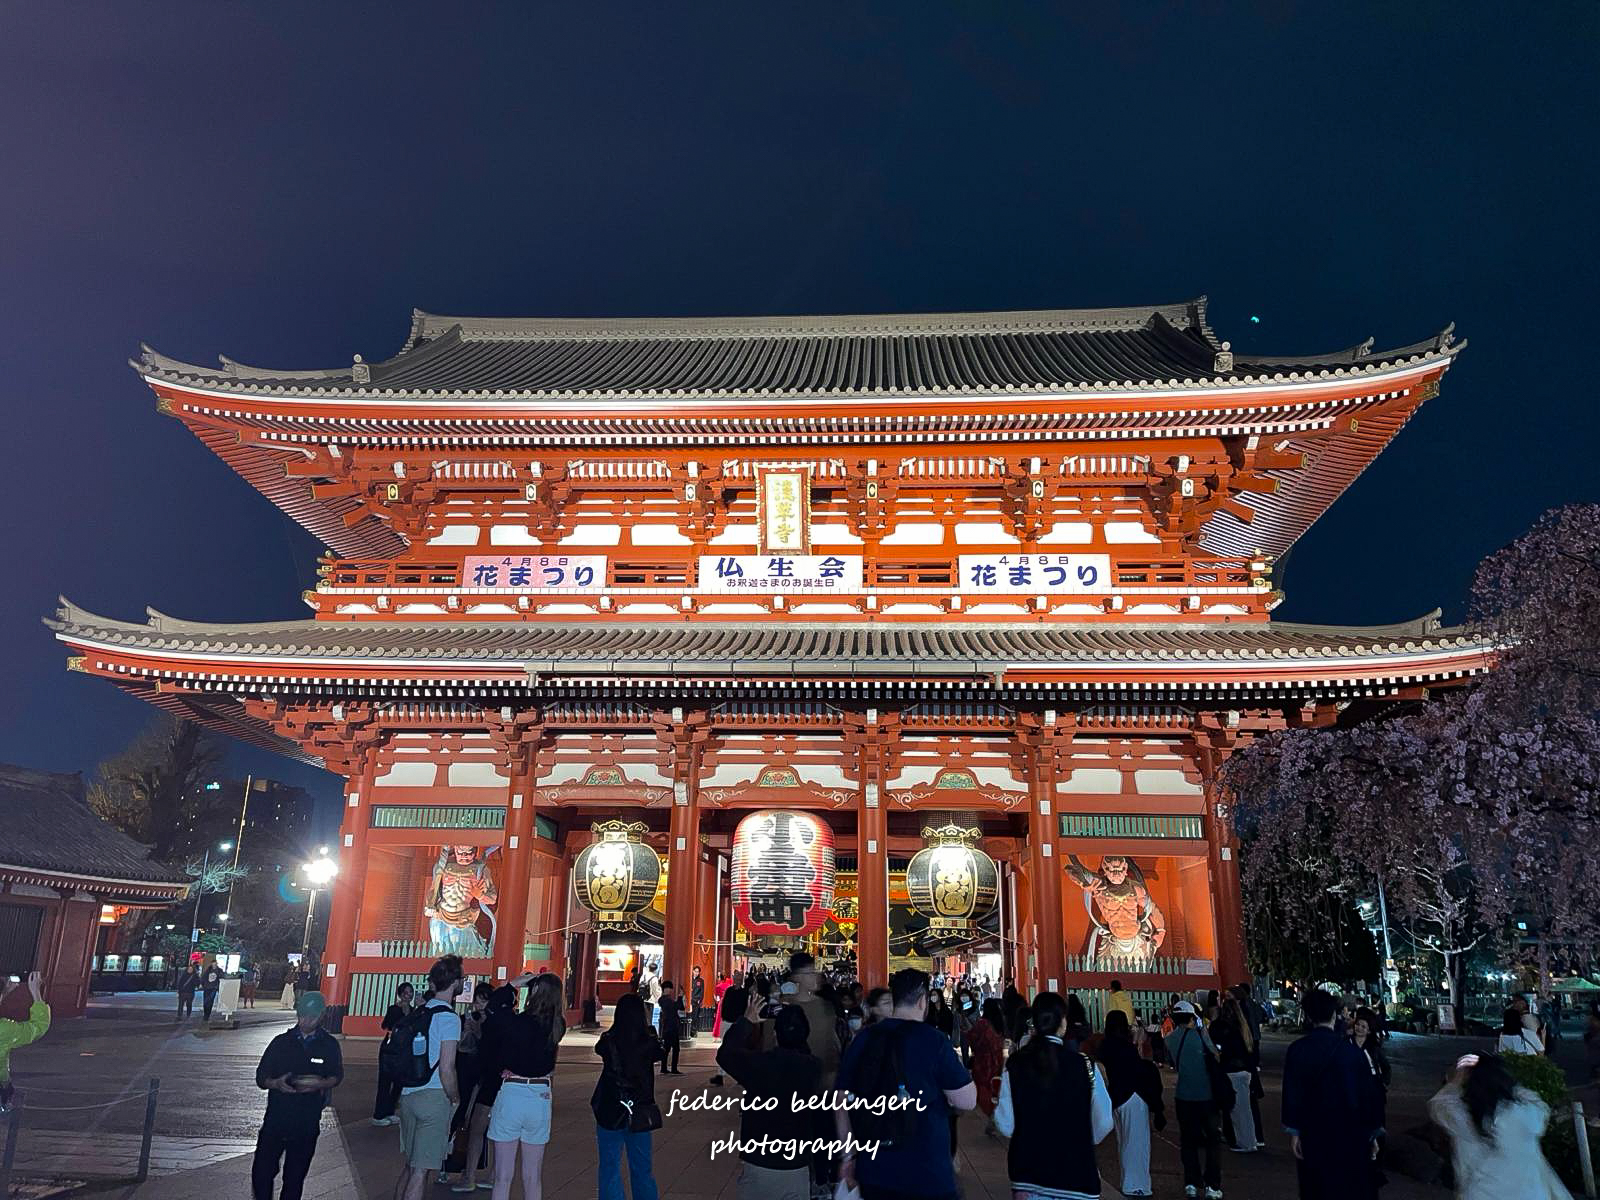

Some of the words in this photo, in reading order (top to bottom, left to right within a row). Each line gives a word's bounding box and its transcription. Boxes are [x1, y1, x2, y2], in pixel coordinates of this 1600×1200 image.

[501, 557, 569, 567] 4月8日
[714, 556, 847, 578] 仏生会
[998, 555, 1070, 566] 4月8日
[473, 564, 594, 587] 花まつり
[970, 564, 1098, 587] 花まつり
